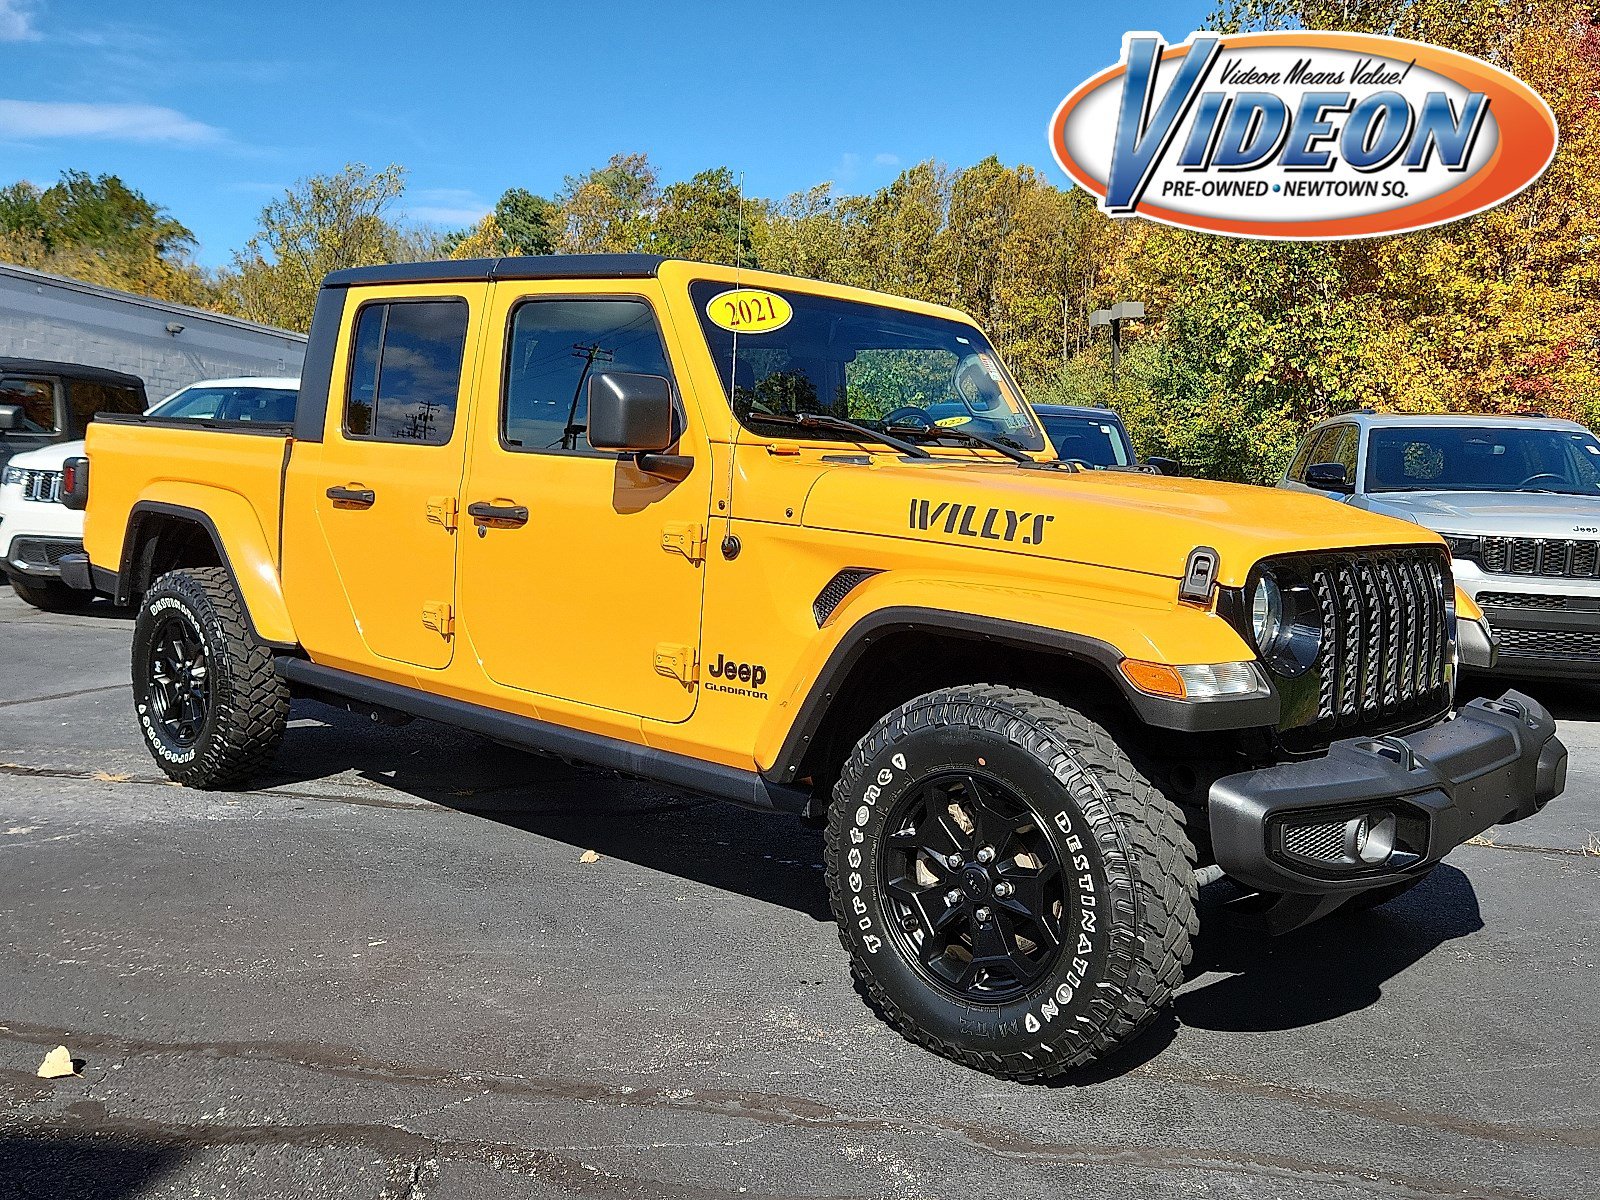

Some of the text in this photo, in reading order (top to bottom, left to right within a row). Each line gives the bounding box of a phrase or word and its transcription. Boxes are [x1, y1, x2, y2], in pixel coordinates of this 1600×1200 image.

[724, 296, 776, 326] 2021
[909, 498, 1055, 545] WILLYS
[1572, 525, 1598, 533] Jeep
[708, 653, 767, 689] Jeep
[704, 682, 768, 701] GLADIATOR
[1040, 810, 1097, 1023] DESTINATION
